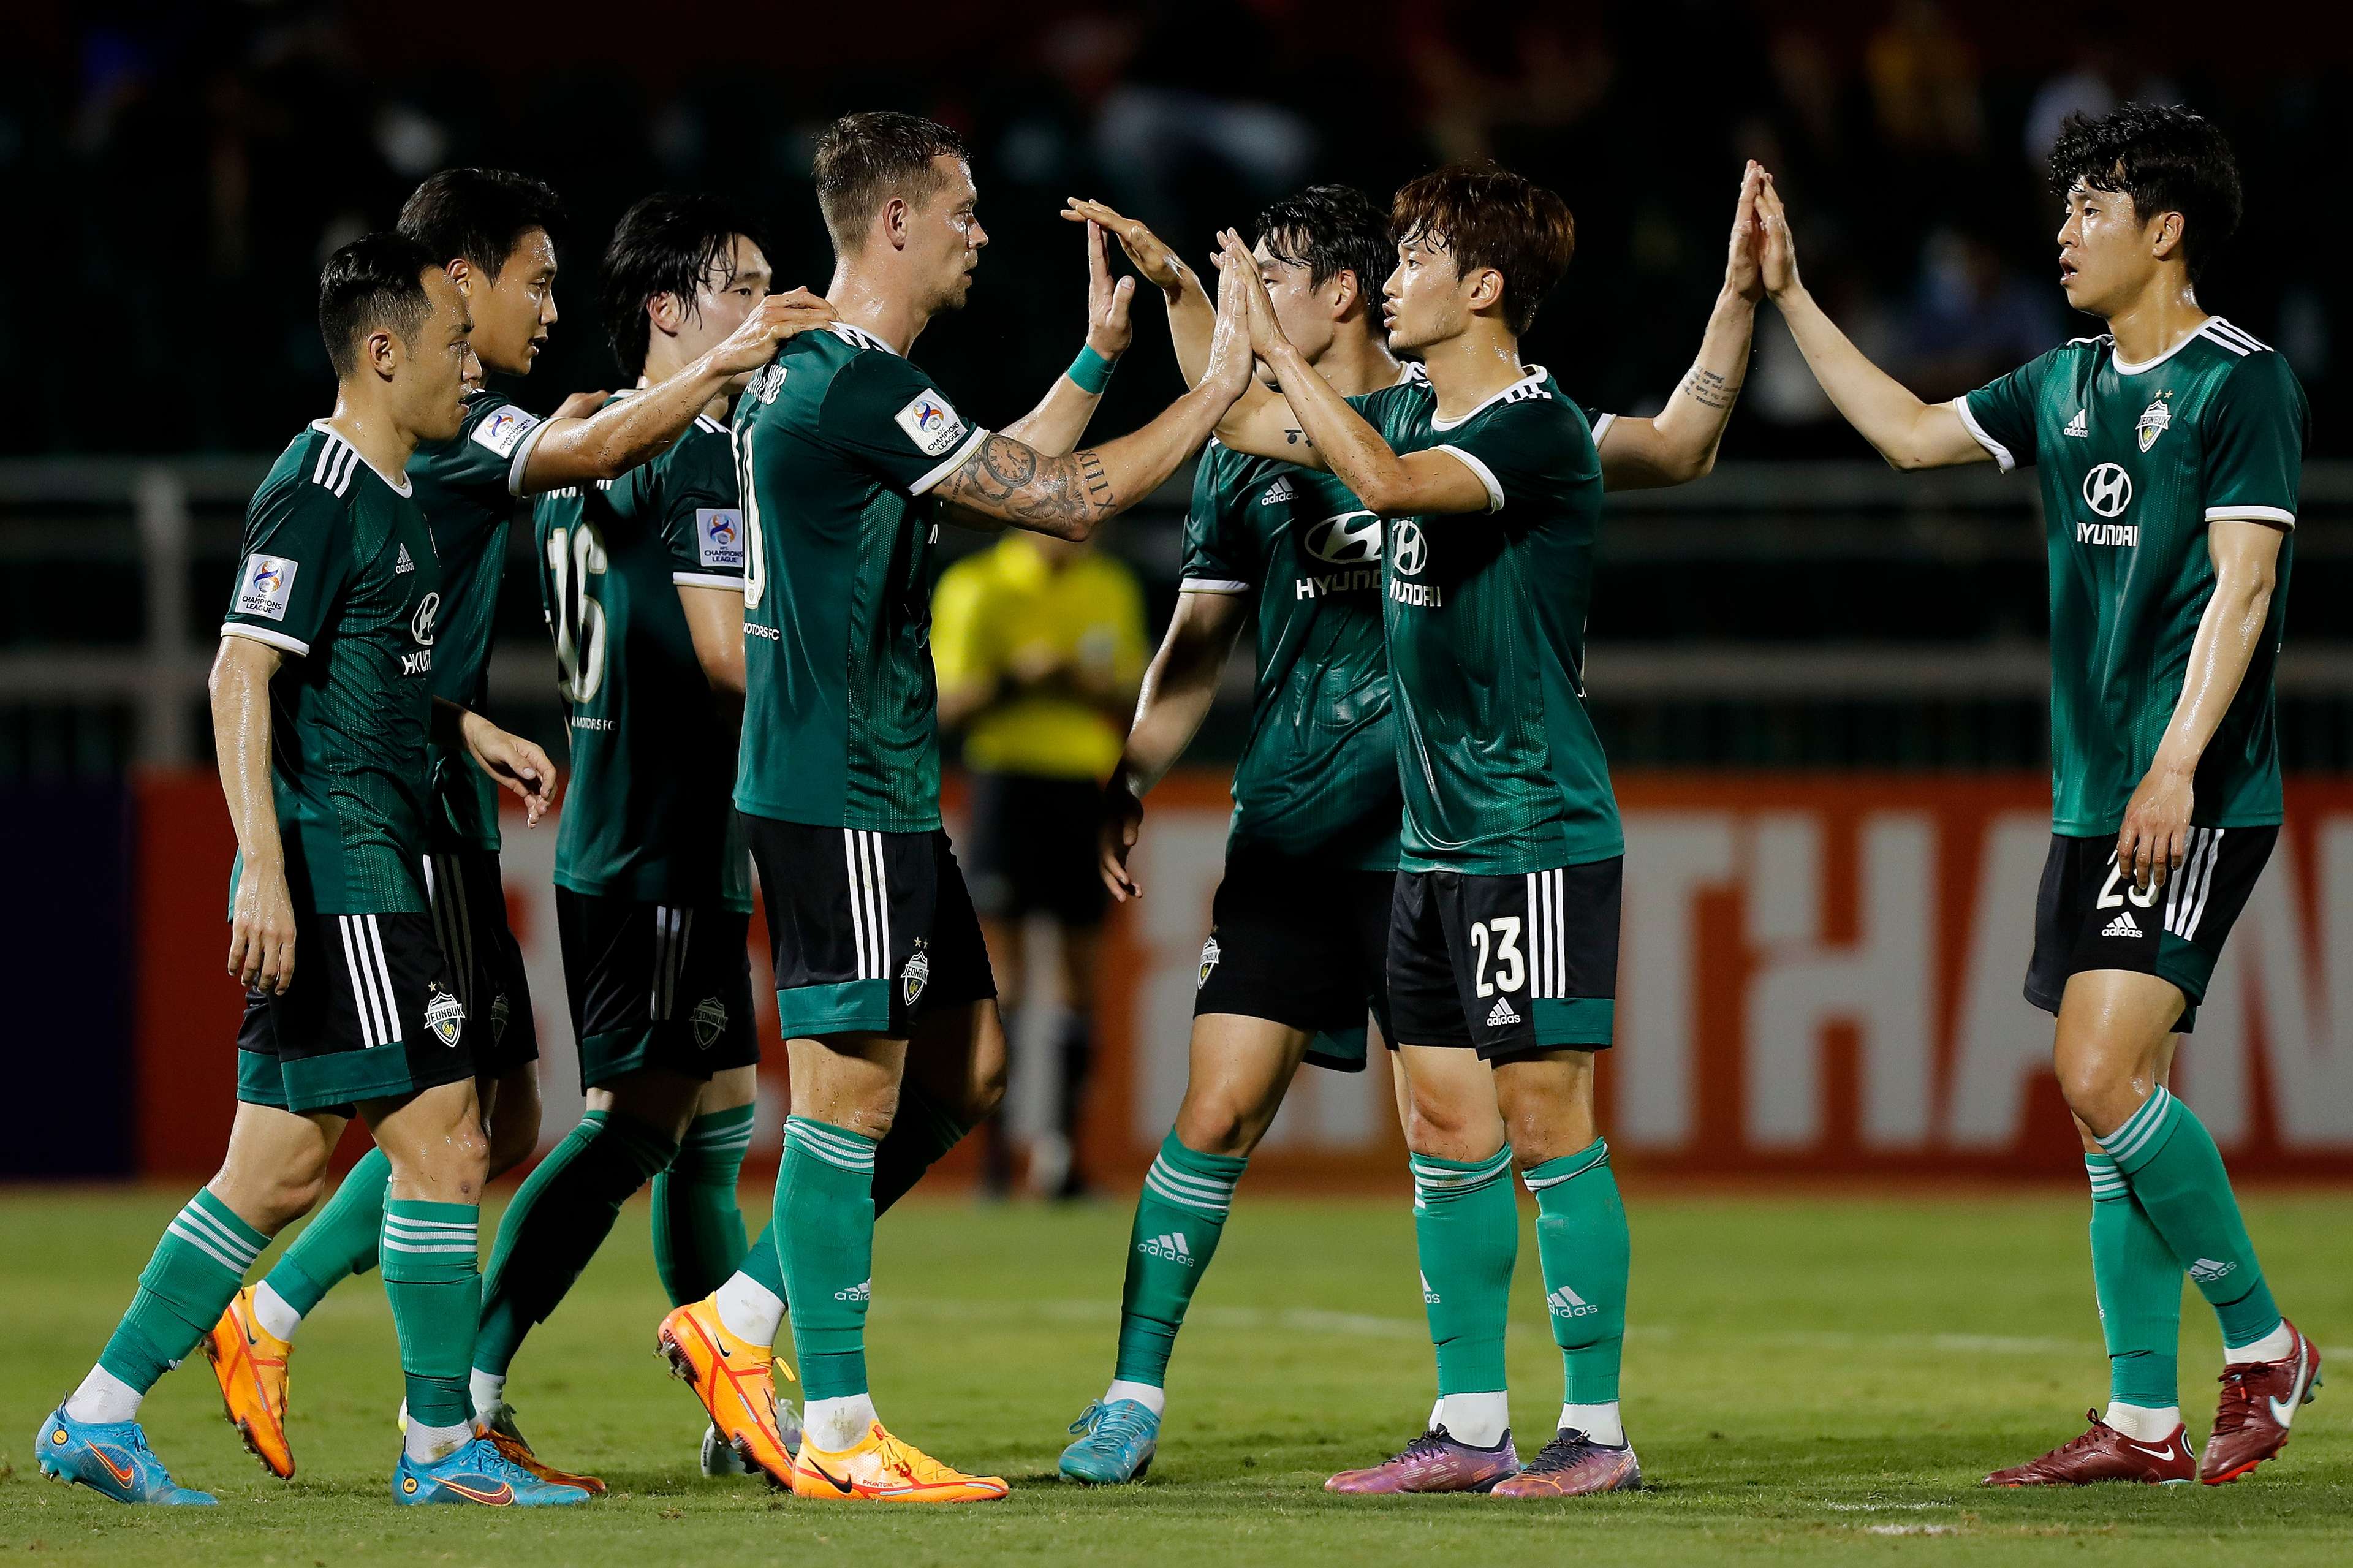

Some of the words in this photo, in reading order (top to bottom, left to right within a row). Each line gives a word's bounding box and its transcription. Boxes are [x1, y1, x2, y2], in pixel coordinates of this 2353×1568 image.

[928, 422, 960, 451] CHAMPIONS
[2063, 426, 2089, 438] adidas
[937, 430, 960, 451] LEAGUE
[242, 596, 282, 610] CHAMPIONS
[246, 603, 276, 614] LEAGUE
[768, 627, 780, 640] FC
[603, 719, 616, 731] FC
[2101, 925, 2143, 939] adidas
[1470, 916, 1525, 999] 23
[426, 1005, 462, 1024] JEONBUK
[1486, 1013, 1521, 1027] adidas
[1137, 1243, 1195, 1267] adidas
[1547, 1305, 1598, 1319] didas
[862, 1479, 894, 1488] PHANTOM
